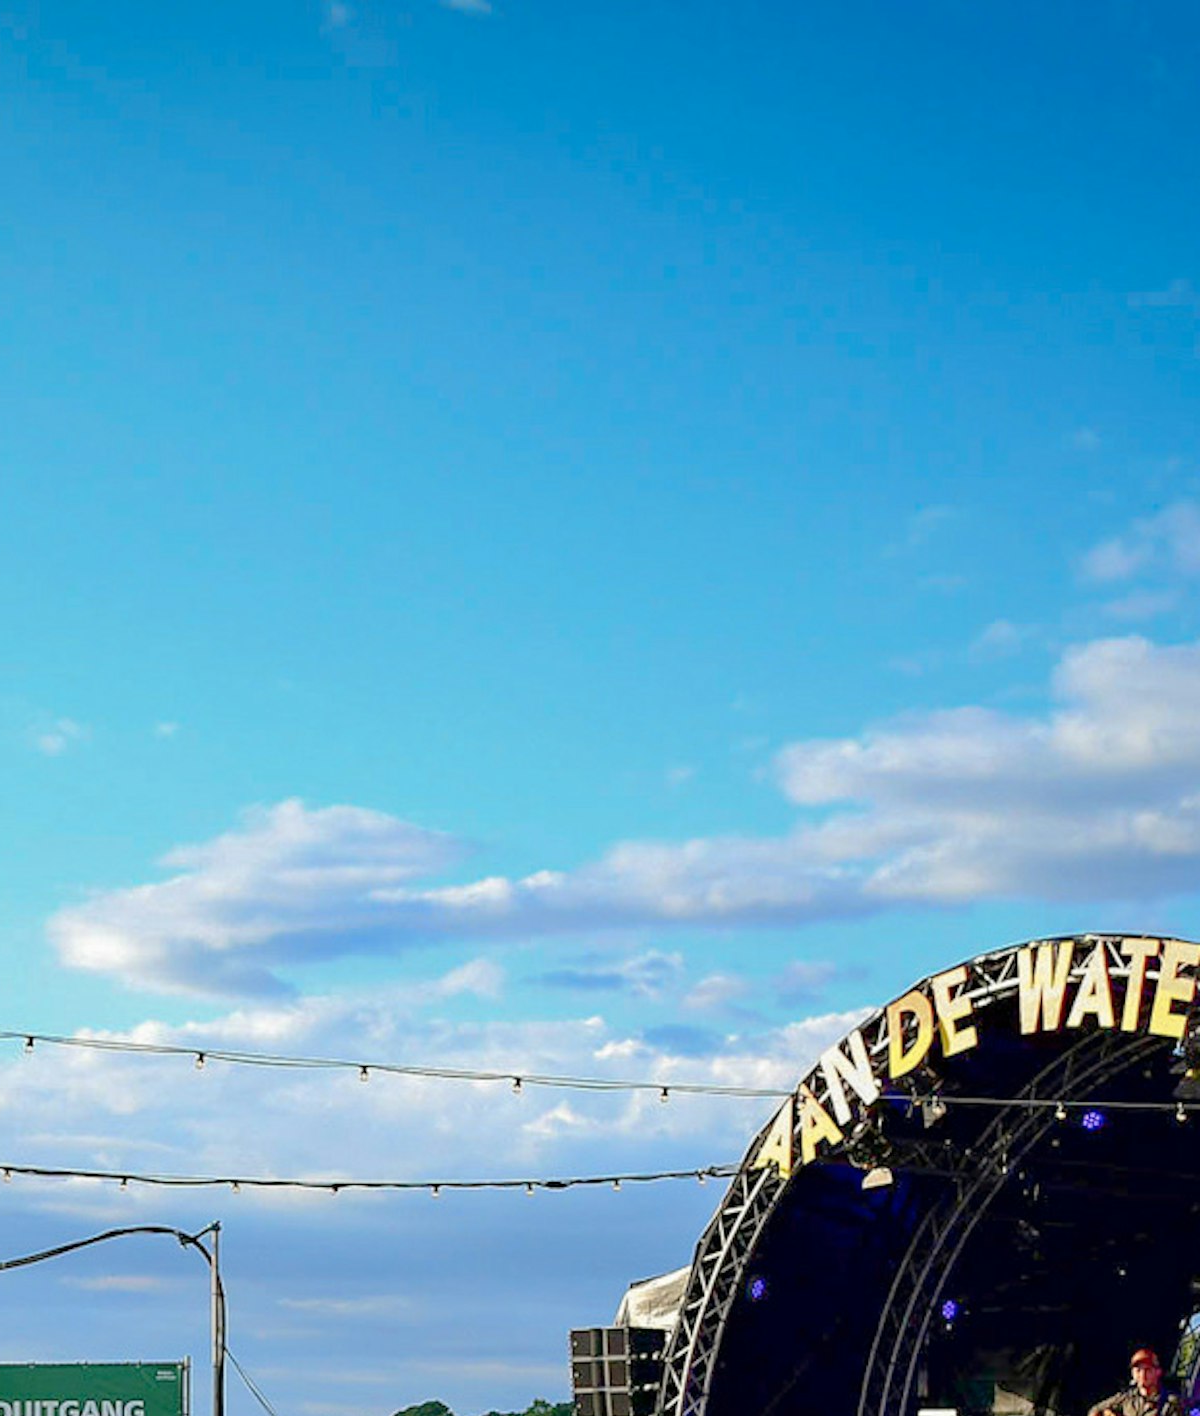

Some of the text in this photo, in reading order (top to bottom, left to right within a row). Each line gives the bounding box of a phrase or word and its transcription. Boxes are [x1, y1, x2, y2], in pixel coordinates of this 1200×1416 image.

[751, 937, 1200, 1179] AAN DE WATE
